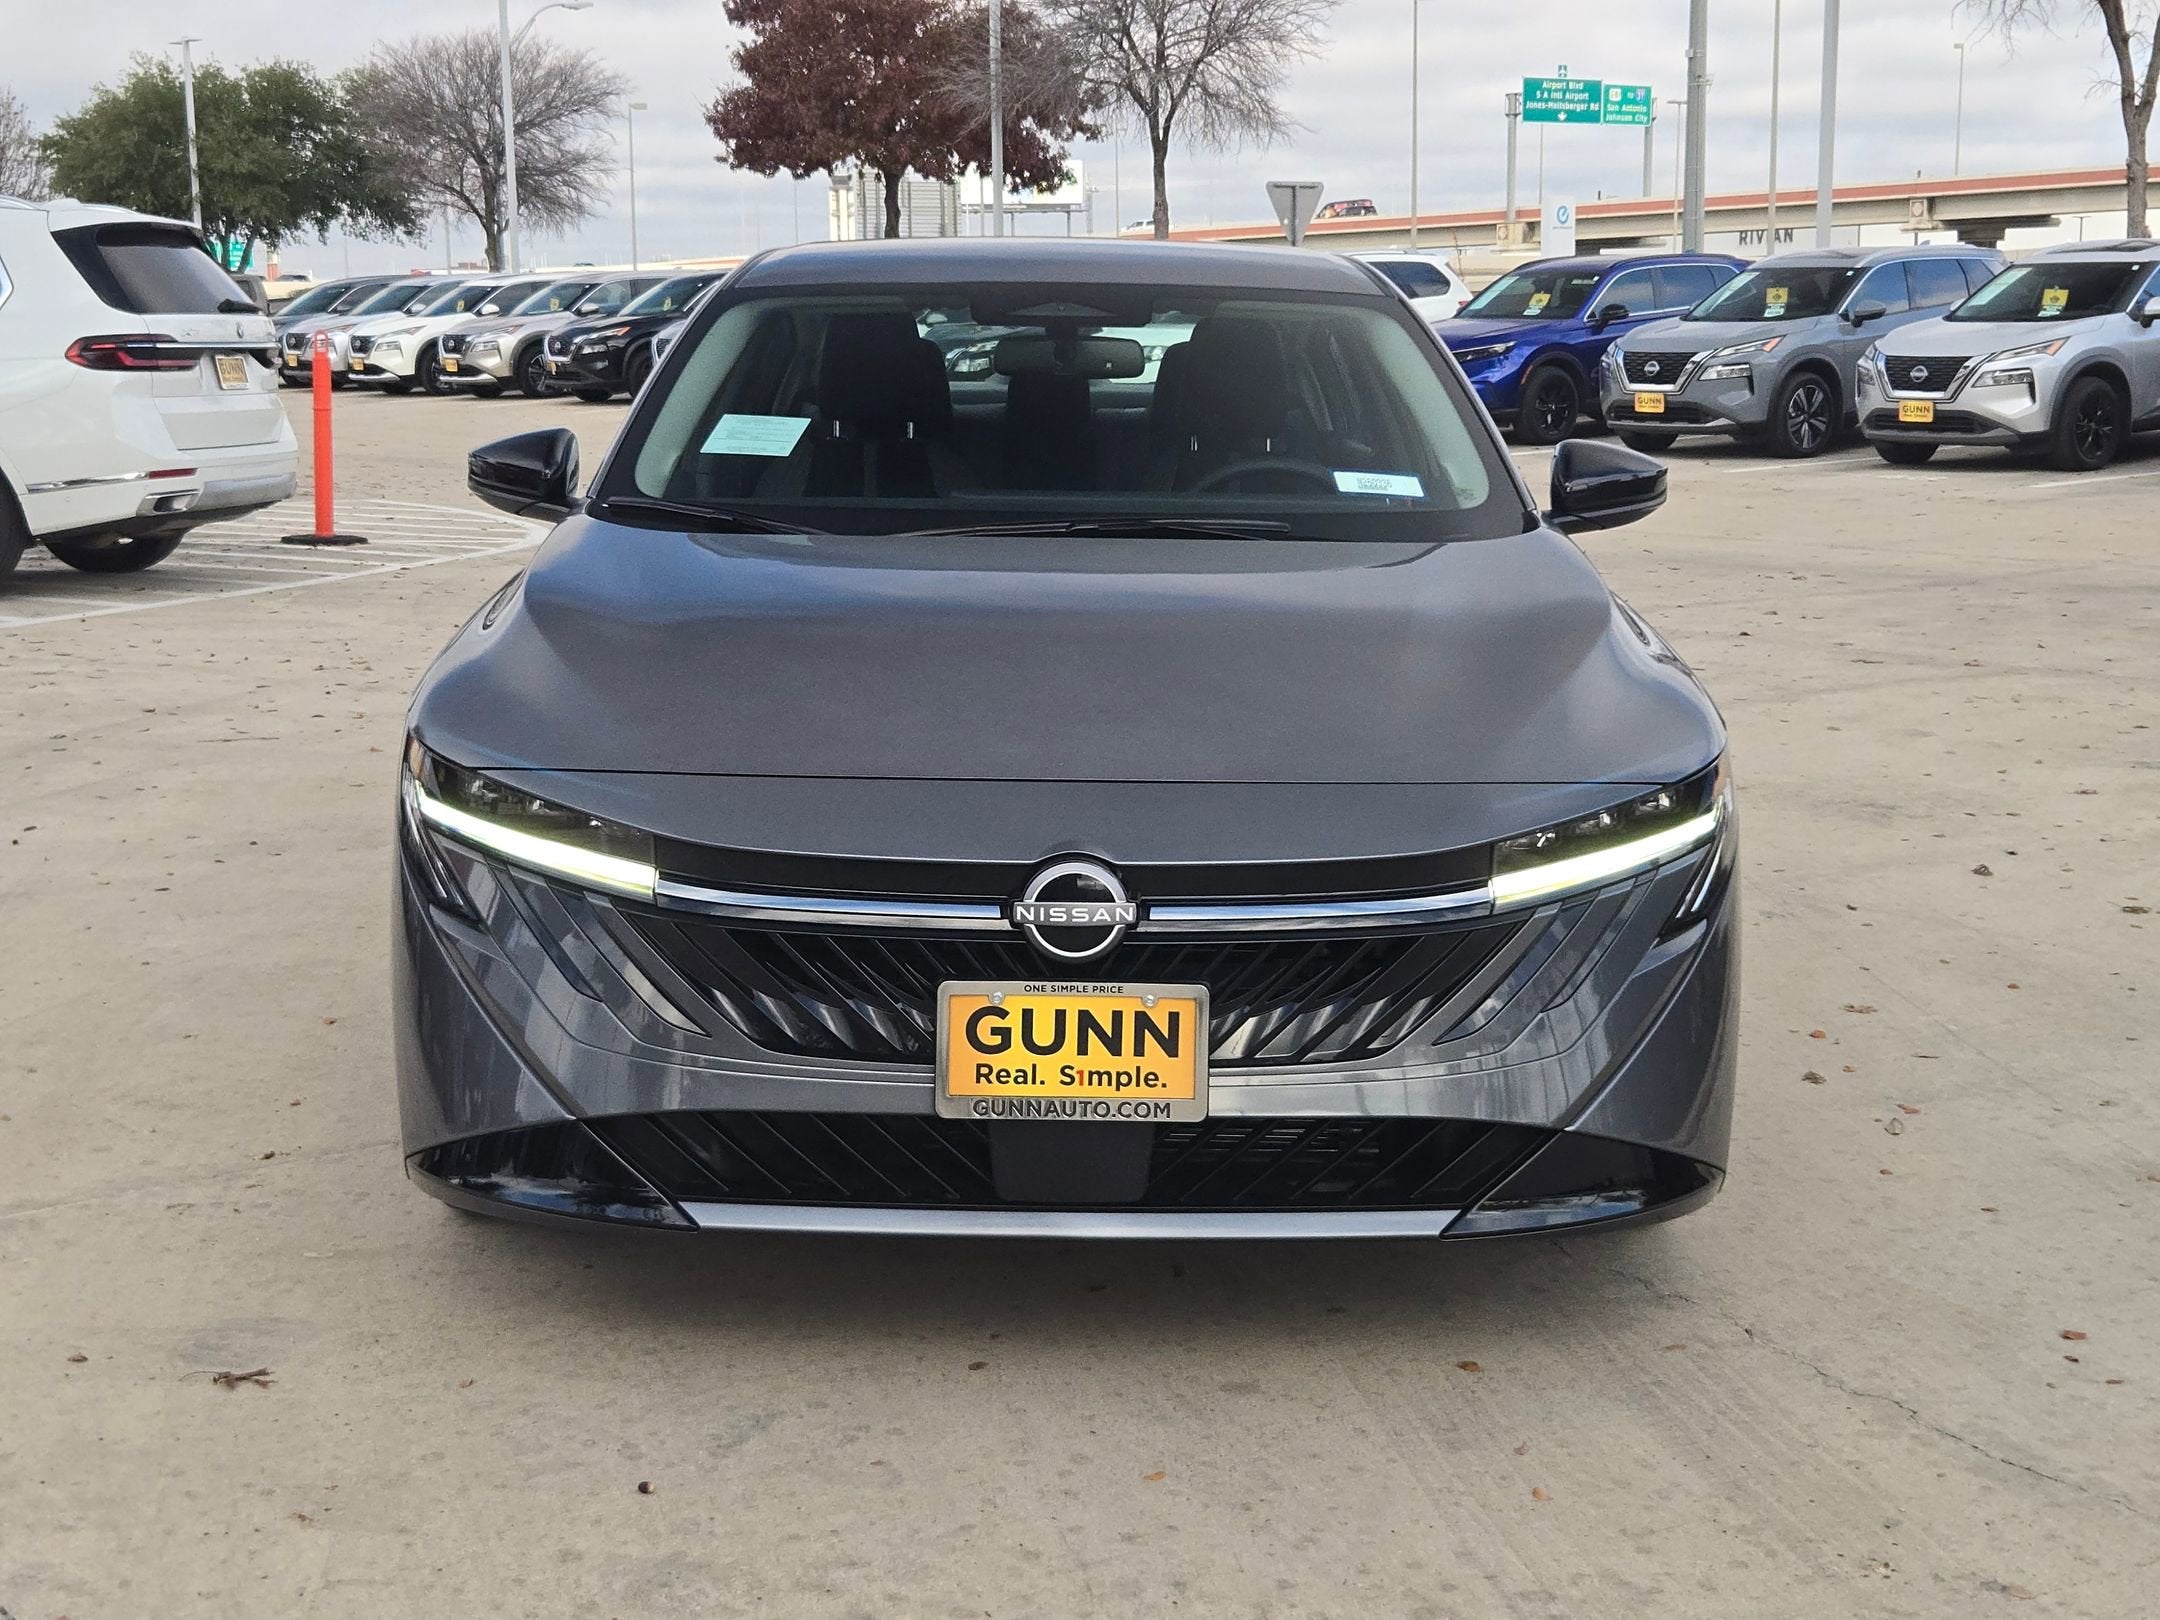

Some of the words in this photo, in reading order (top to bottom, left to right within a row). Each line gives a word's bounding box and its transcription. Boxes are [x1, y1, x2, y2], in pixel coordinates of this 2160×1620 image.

[1542, 80, 1566, 90] Airport
[1569, 81, 1584, 90] Blvd
[1543, 90, 1548, 99] A
[1565, 91, 1589, 101] Airport
[1590, 102, 1600, 111] Rd
[1621, 104, 1647, 112] Antonio
[1606, 113, 1633, 121] Johnson
[1634, 114, 1648, 124] City
[1739, 229, 1793, 245] RIVAN
[220, 363, 244, 374] GUNN
[1016, 906, 1134, 922] NISSAN
[1023, 984, 1047, 993] ONE
[1050, 984, 1089, 994] SIMPLE
[1092, 985, 1124, 994] PRICE
[965, 1005, 1180, 1059] GUNN
[975, 1063, 1046, 1086] Real.
[972, 1100, 1171, 1119] GUNNAUTO.COM
